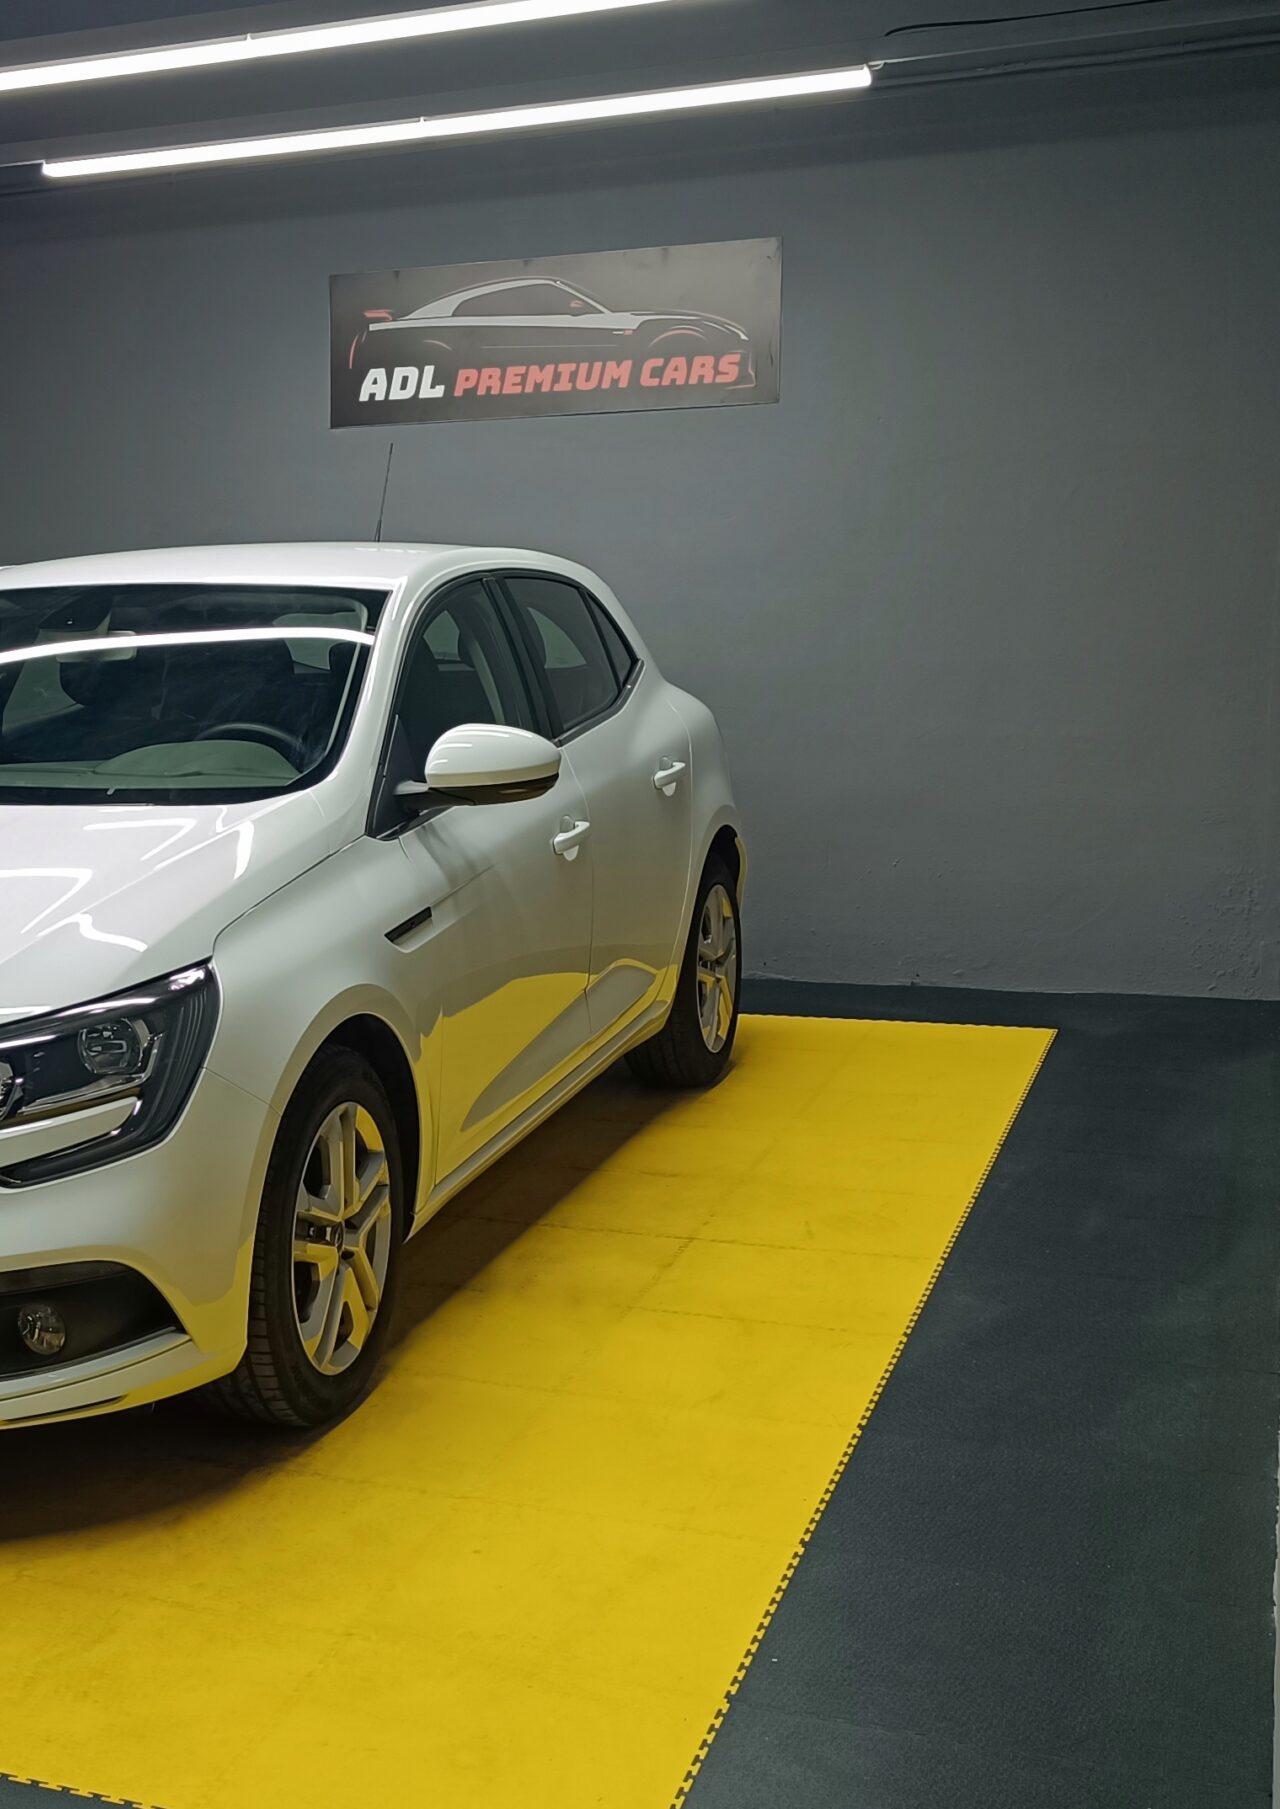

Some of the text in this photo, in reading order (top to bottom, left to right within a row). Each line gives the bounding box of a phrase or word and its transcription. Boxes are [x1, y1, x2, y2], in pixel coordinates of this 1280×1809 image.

[359, 353, 742, 402] ADL PREMIUM CARS
